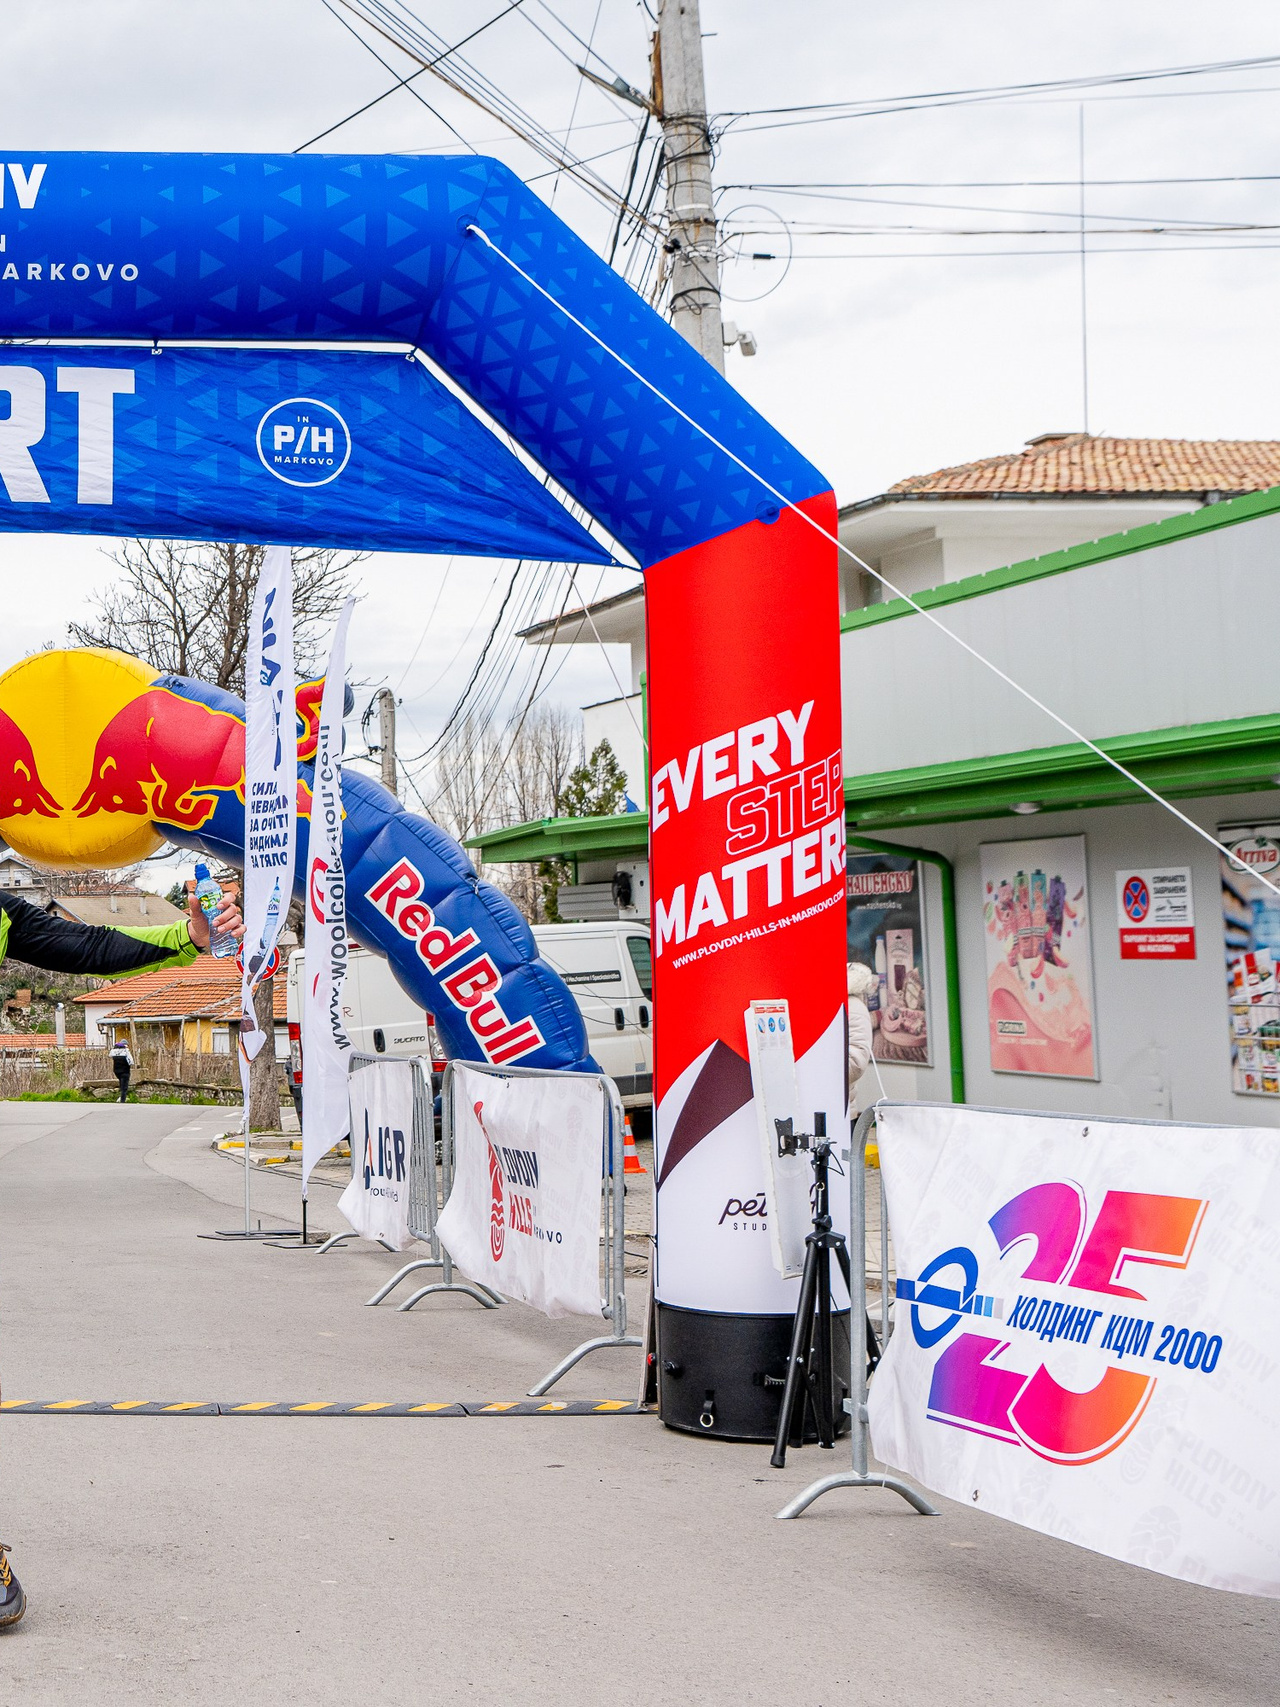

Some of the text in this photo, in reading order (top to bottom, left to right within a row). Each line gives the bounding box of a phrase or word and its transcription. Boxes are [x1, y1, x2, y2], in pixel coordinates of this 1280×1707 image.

[297, 415, 309, 423] IN
[273, 424, 334, 454] P/H
[274, 455, 334, 466] MARKOVO
[652, 700, 814, 832] EVERY
[252, 782, 277, 796] СИЛА
[726, 748, 843, 855] STEP
[259, 852, 287, 867] ТЯЛО
[655, 808, 846, 958] MATTER
[366, 858, 545, 1066] Red Bull
[733, 1221, 767, 1231] STUD
[1007, 1295, 1101, 1345] ХОЛДИНГ
[1100, 1316, 1154, 1359] КЦМ
[1153, 1325, 1223, 1373] 2000
